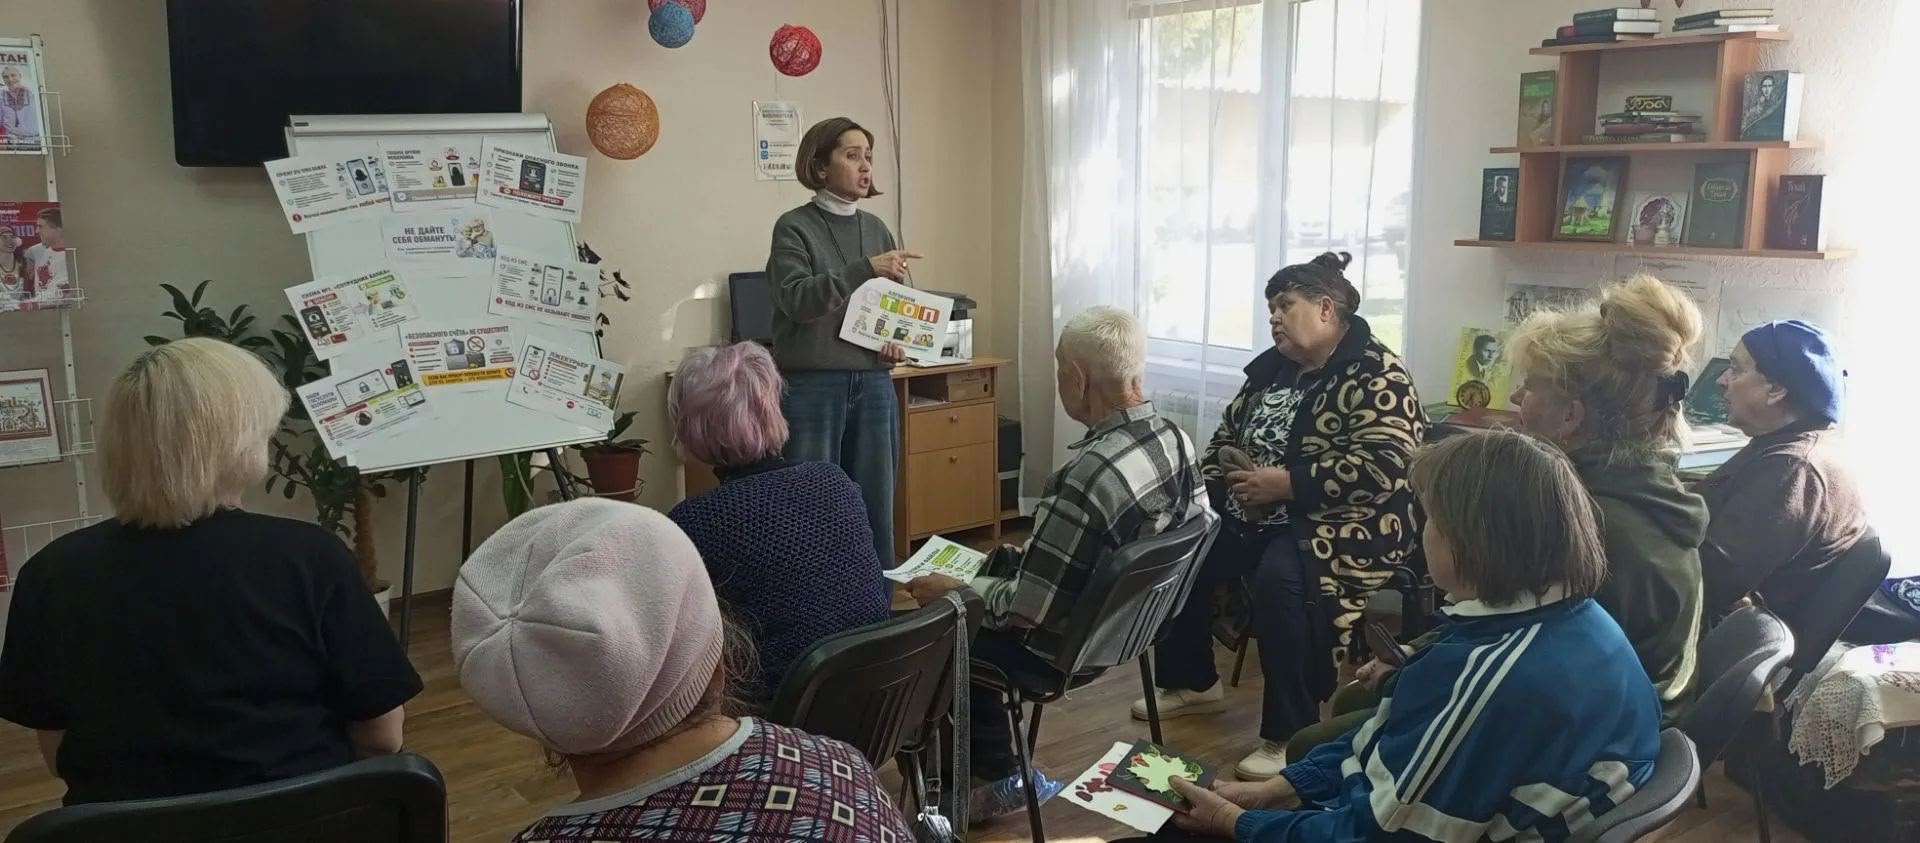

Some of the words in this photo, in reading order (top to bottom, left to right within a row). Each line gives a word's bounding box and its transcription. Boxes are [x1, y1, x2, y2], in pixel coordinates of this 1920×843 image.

[525, 154, 555, 166] ОПАСНОГО
[556, 161, 579, 170] ЗВОНКА
[405, 227, 416, 235] НЕ
[418, 225, 445, 236] ДАЙТЕ
[392, 236, 413, 244] СЕБЯ
[414, 234, 457, 243] ОБМАНУТЬ!
[525, 303, 536, 311] СМС
[550, 352, 589, 369] ЛЖЕКУРЬЕР
